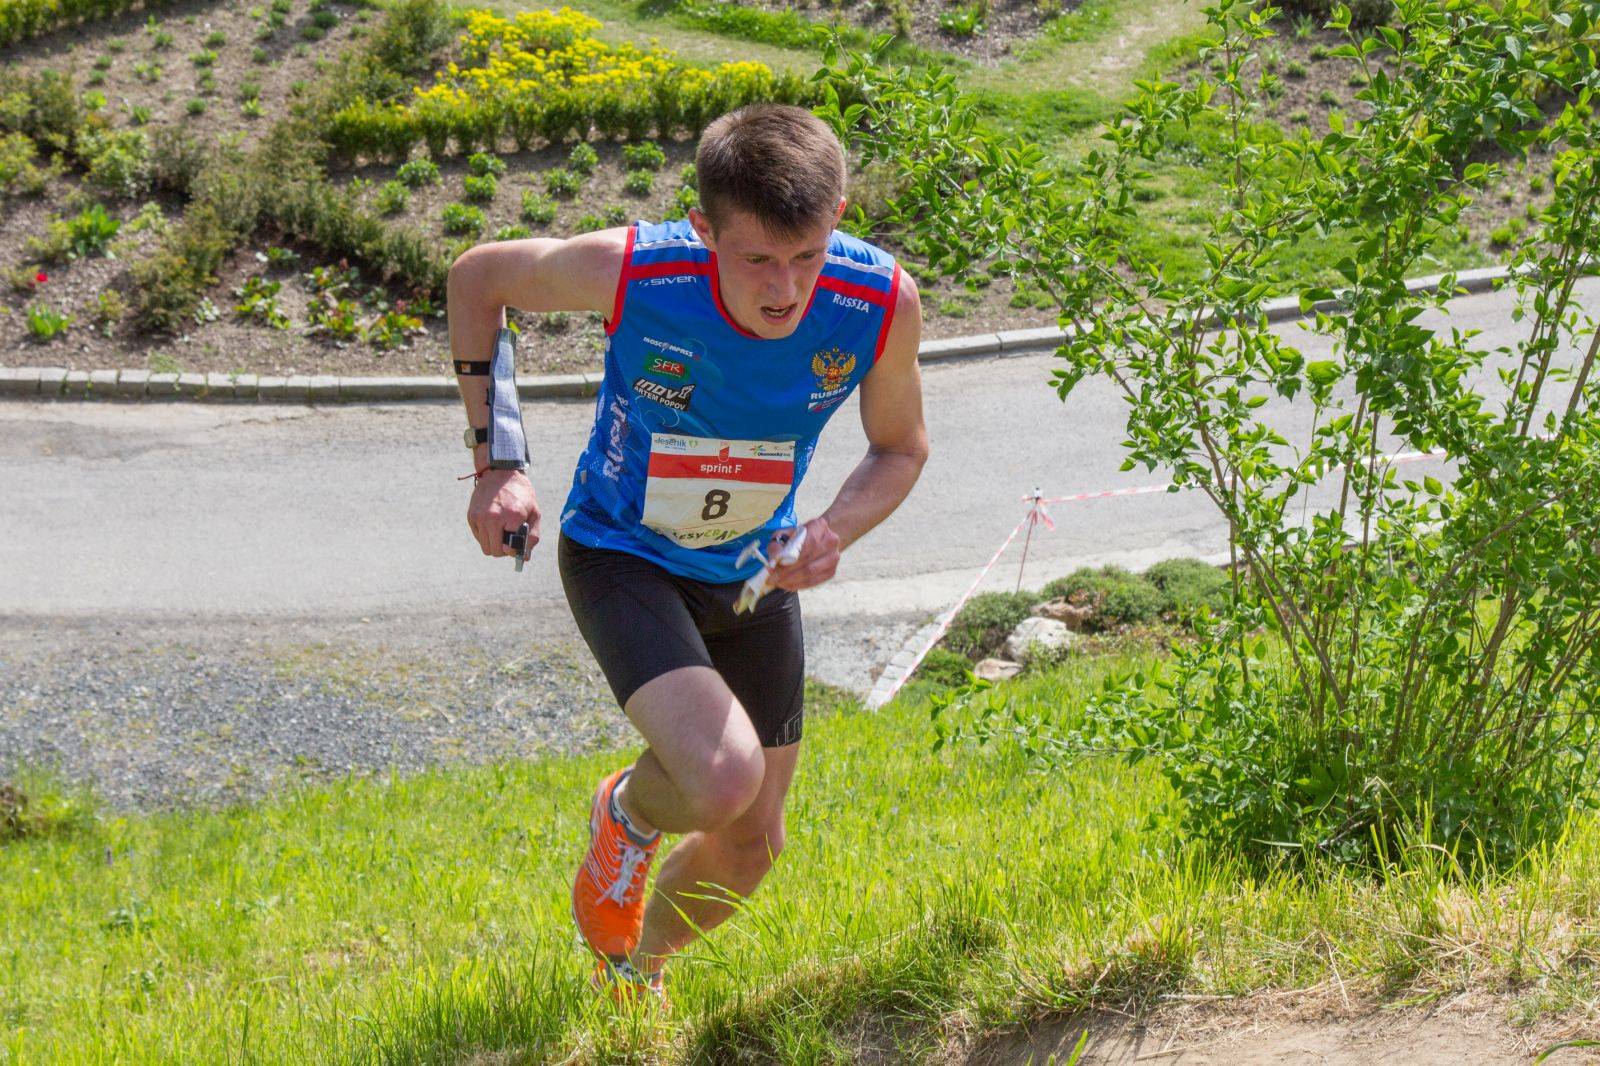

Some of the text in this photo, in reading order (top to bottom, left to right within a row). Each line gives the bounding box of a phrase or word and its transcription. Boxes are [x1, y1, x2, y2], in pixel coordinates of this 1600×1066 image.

[832, 293, 870, 313] RUSSIA
[653, 358, 681, 373] SFR
[634, 385, 659, 401] ARTEM
[660, 398, 686, 411] POPOV
[810, 386, 848, 400] RUSSIA
[700, 463, 743, 474] sprint F
[701, 488, 731, 521] 8
